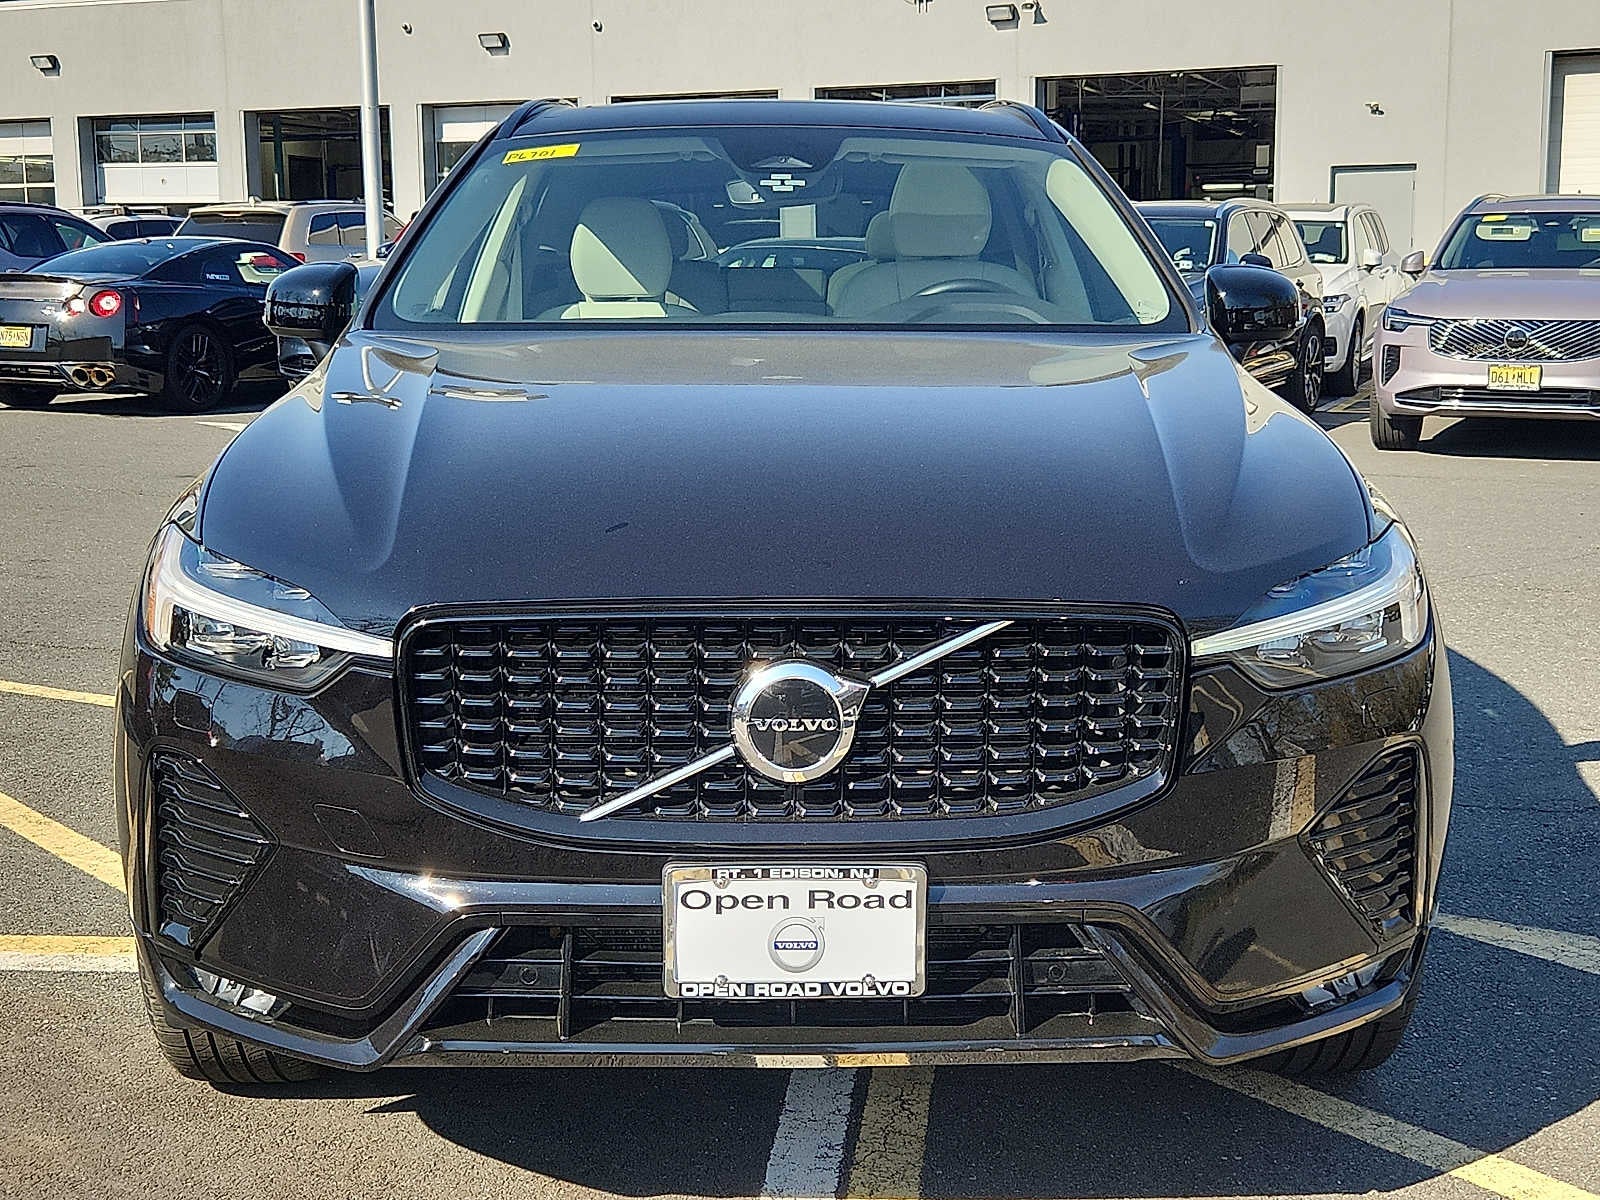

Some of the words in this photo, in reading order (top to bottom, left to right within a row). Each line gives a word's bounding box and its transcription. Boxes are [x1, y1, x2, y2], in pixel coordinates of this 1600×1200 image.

[751, 718, 838, 731] VOLVO
[716, 868, 746, 879] RT.
[753, 868, 763, 879] 1
[769, 868, 844, 879] EDISON,
[850, 868, 875, 879] NJ
[680, 889, 790, 914] Open
[808, 889, 913, 910] Road
[681, 983, 746, 997] OPEN
[754, 983, 821, 997] ROAD
[829, 983, 910, 997] VOLVO
